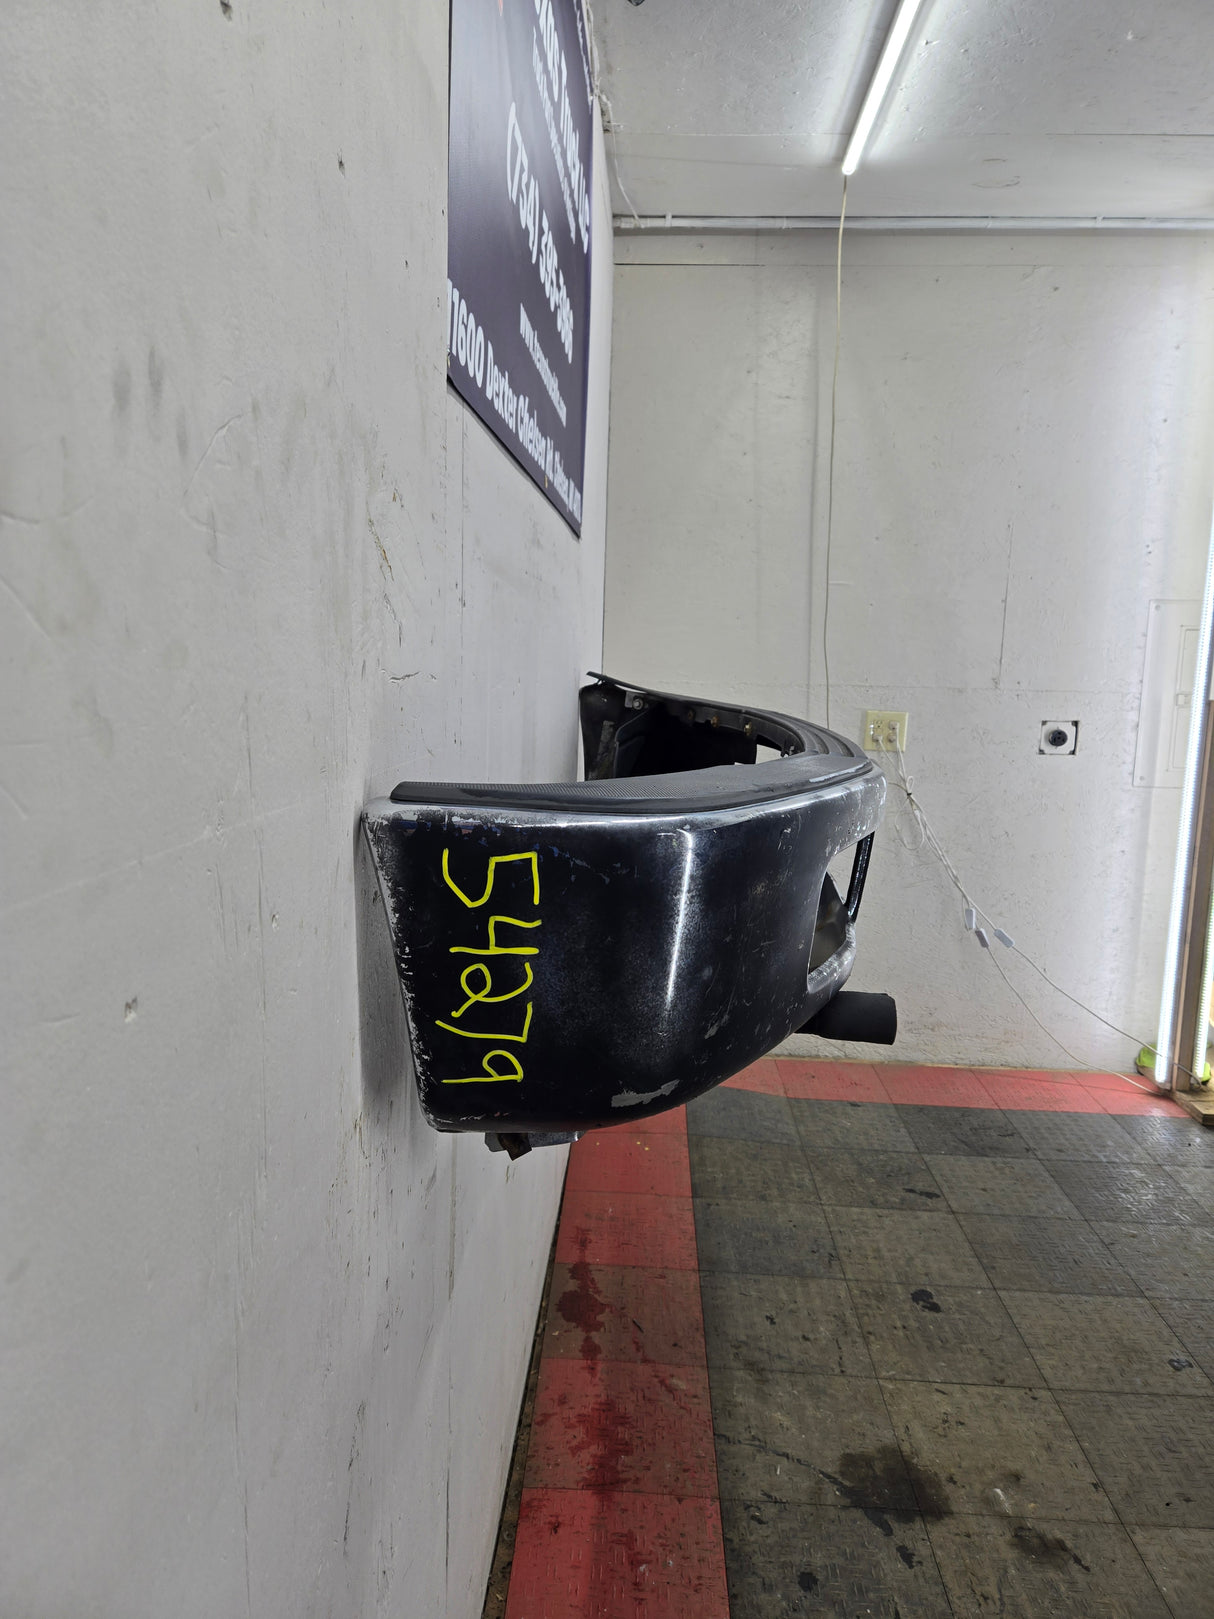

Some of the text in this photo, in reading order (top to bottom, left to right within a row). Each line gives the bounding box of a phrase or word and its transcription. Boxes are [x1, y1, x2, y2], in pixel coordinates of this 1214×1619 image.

[507, 102, 539, 264] (734)
[485, 340, 517, 433] Dexter
[518, 394, 546, 471] Chelsea
[435, 848, 542, 1083] 54279
